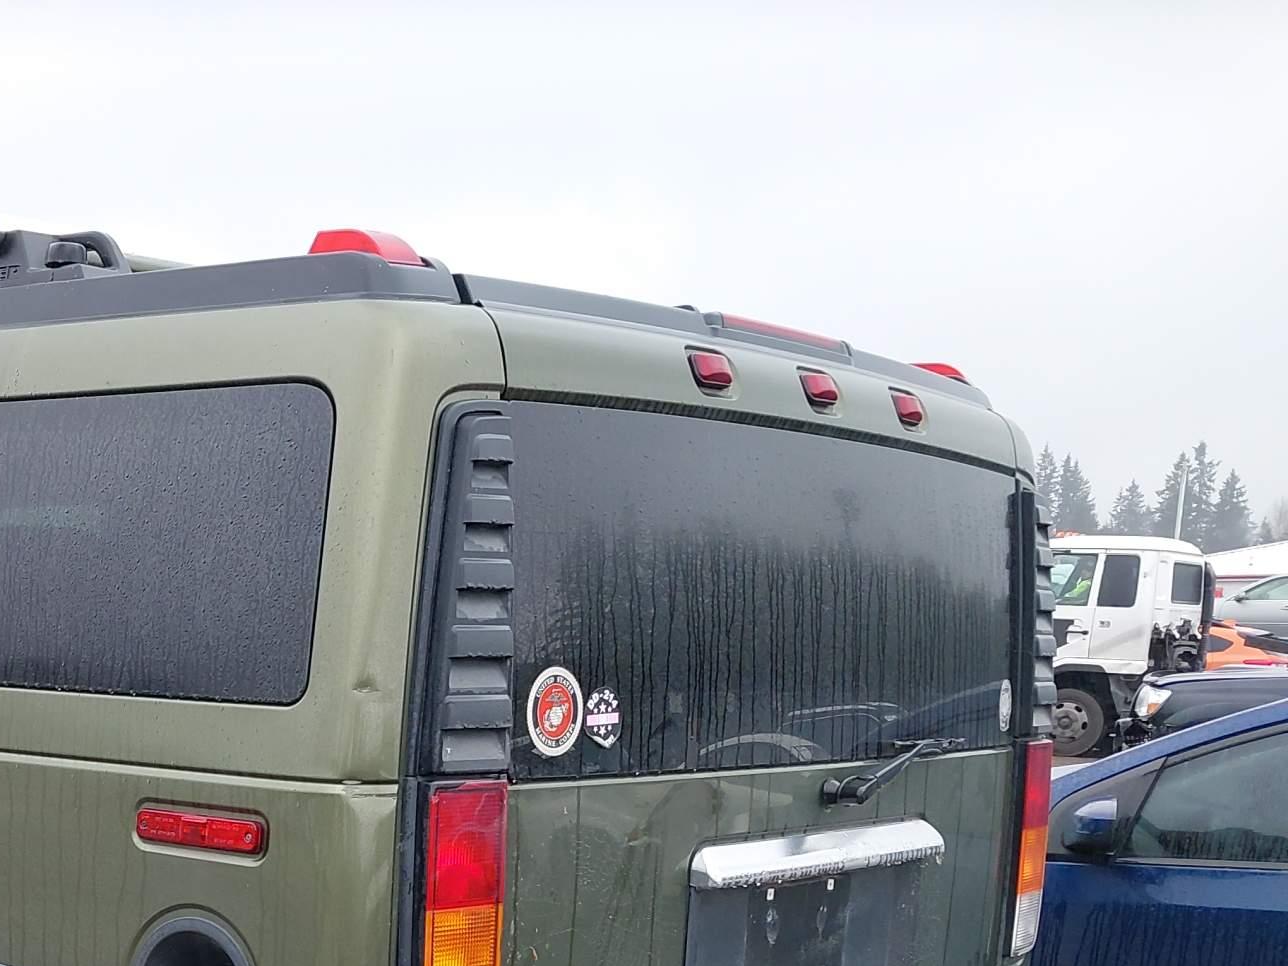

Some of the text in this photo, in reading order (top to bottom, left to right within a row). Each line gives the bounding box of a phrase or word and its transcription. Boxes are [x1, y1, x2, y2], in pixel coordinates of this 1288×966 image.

[536, 676, 574, 698] UNITED STATES
[587, 689, 618, 710] DD-214
[535, 723, 575, 747] MARINE CORPS
